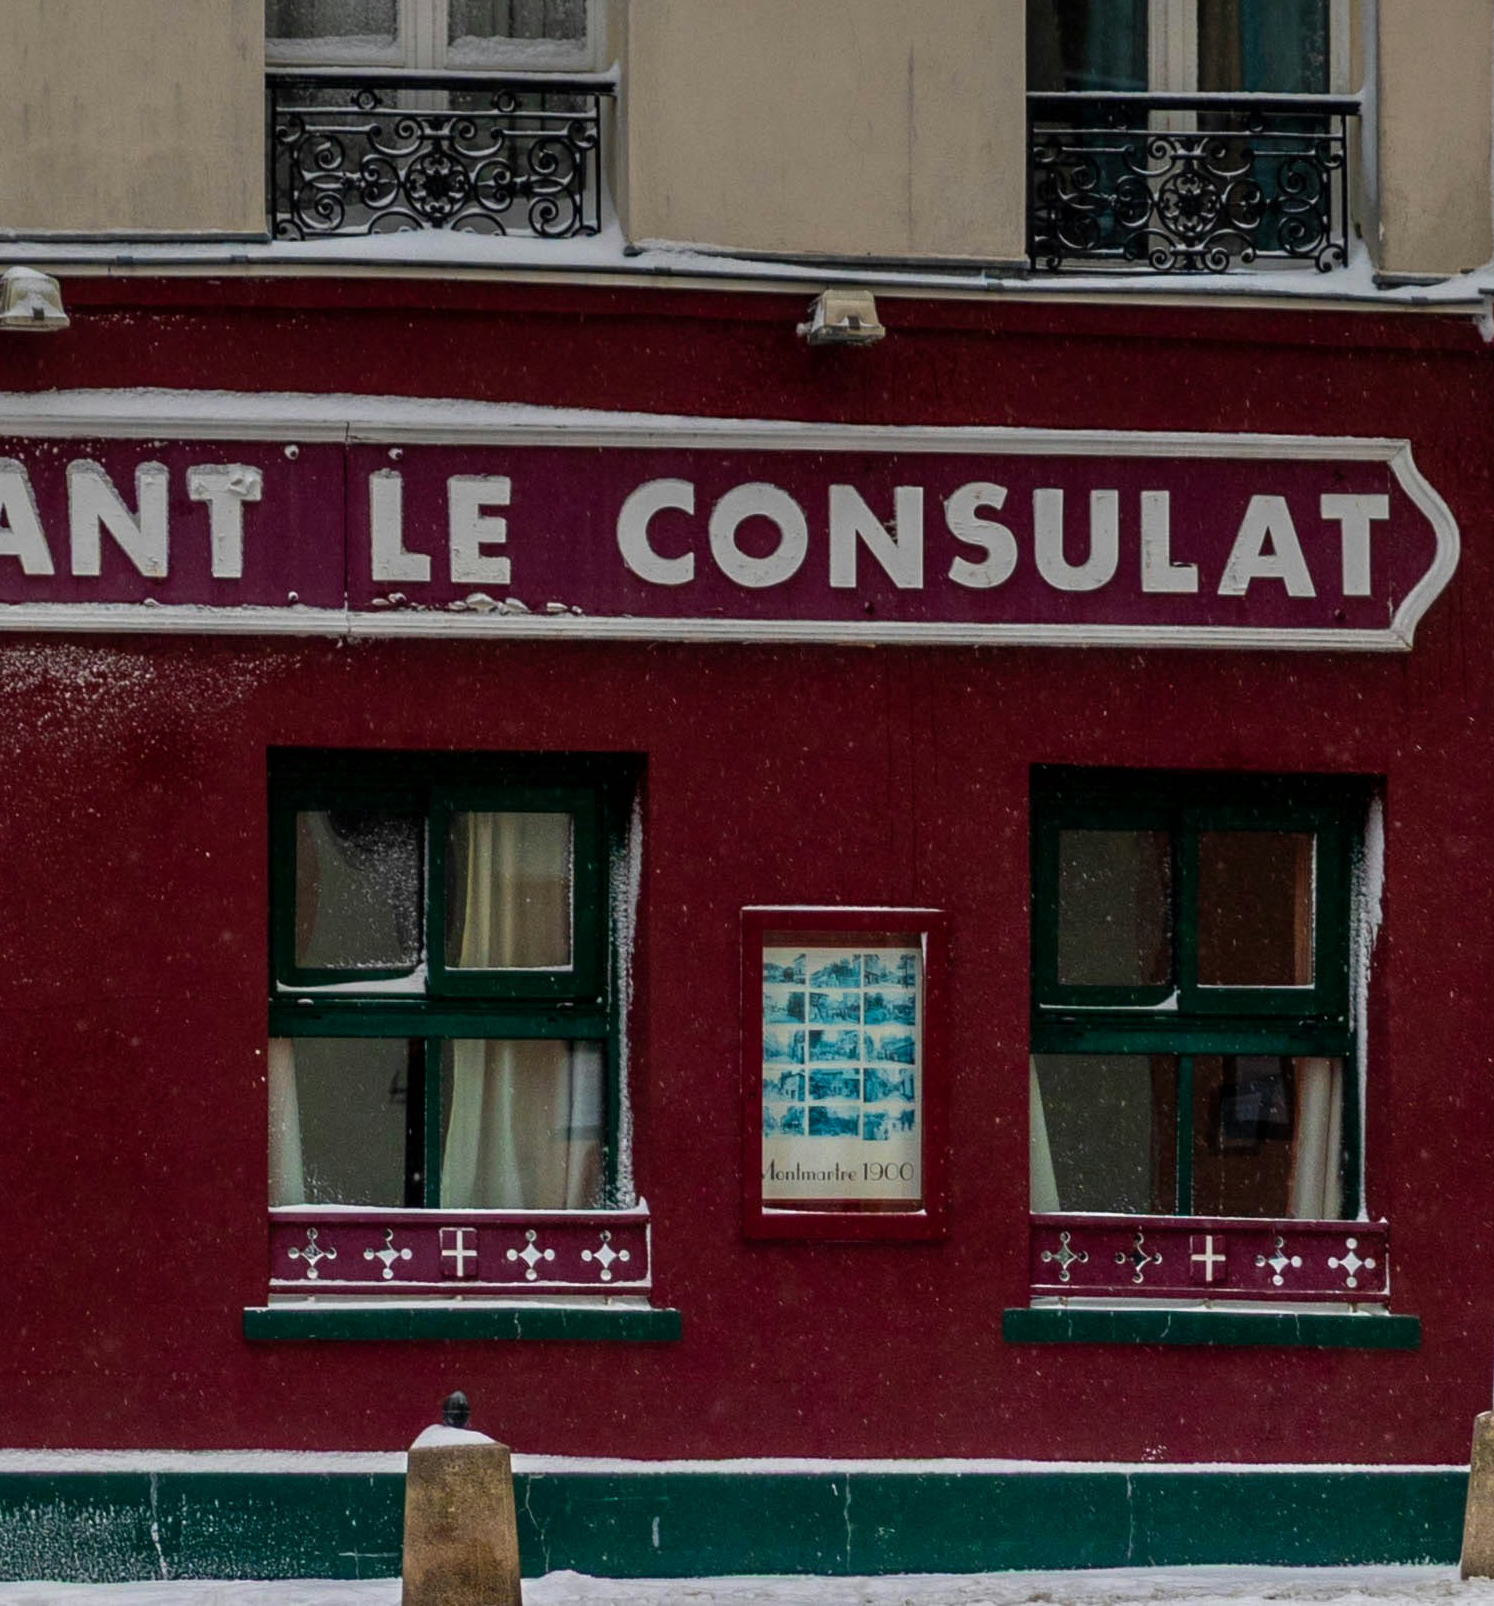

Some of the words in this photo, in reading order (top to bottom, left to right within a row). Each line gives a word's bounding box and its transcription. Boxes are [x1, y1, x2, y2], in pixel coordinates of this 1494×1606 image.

[369, 466, 512, 586] LE
[616, 476, 1390, 600] CONSULAT
[863, 1161, 914, 1182] 1900
